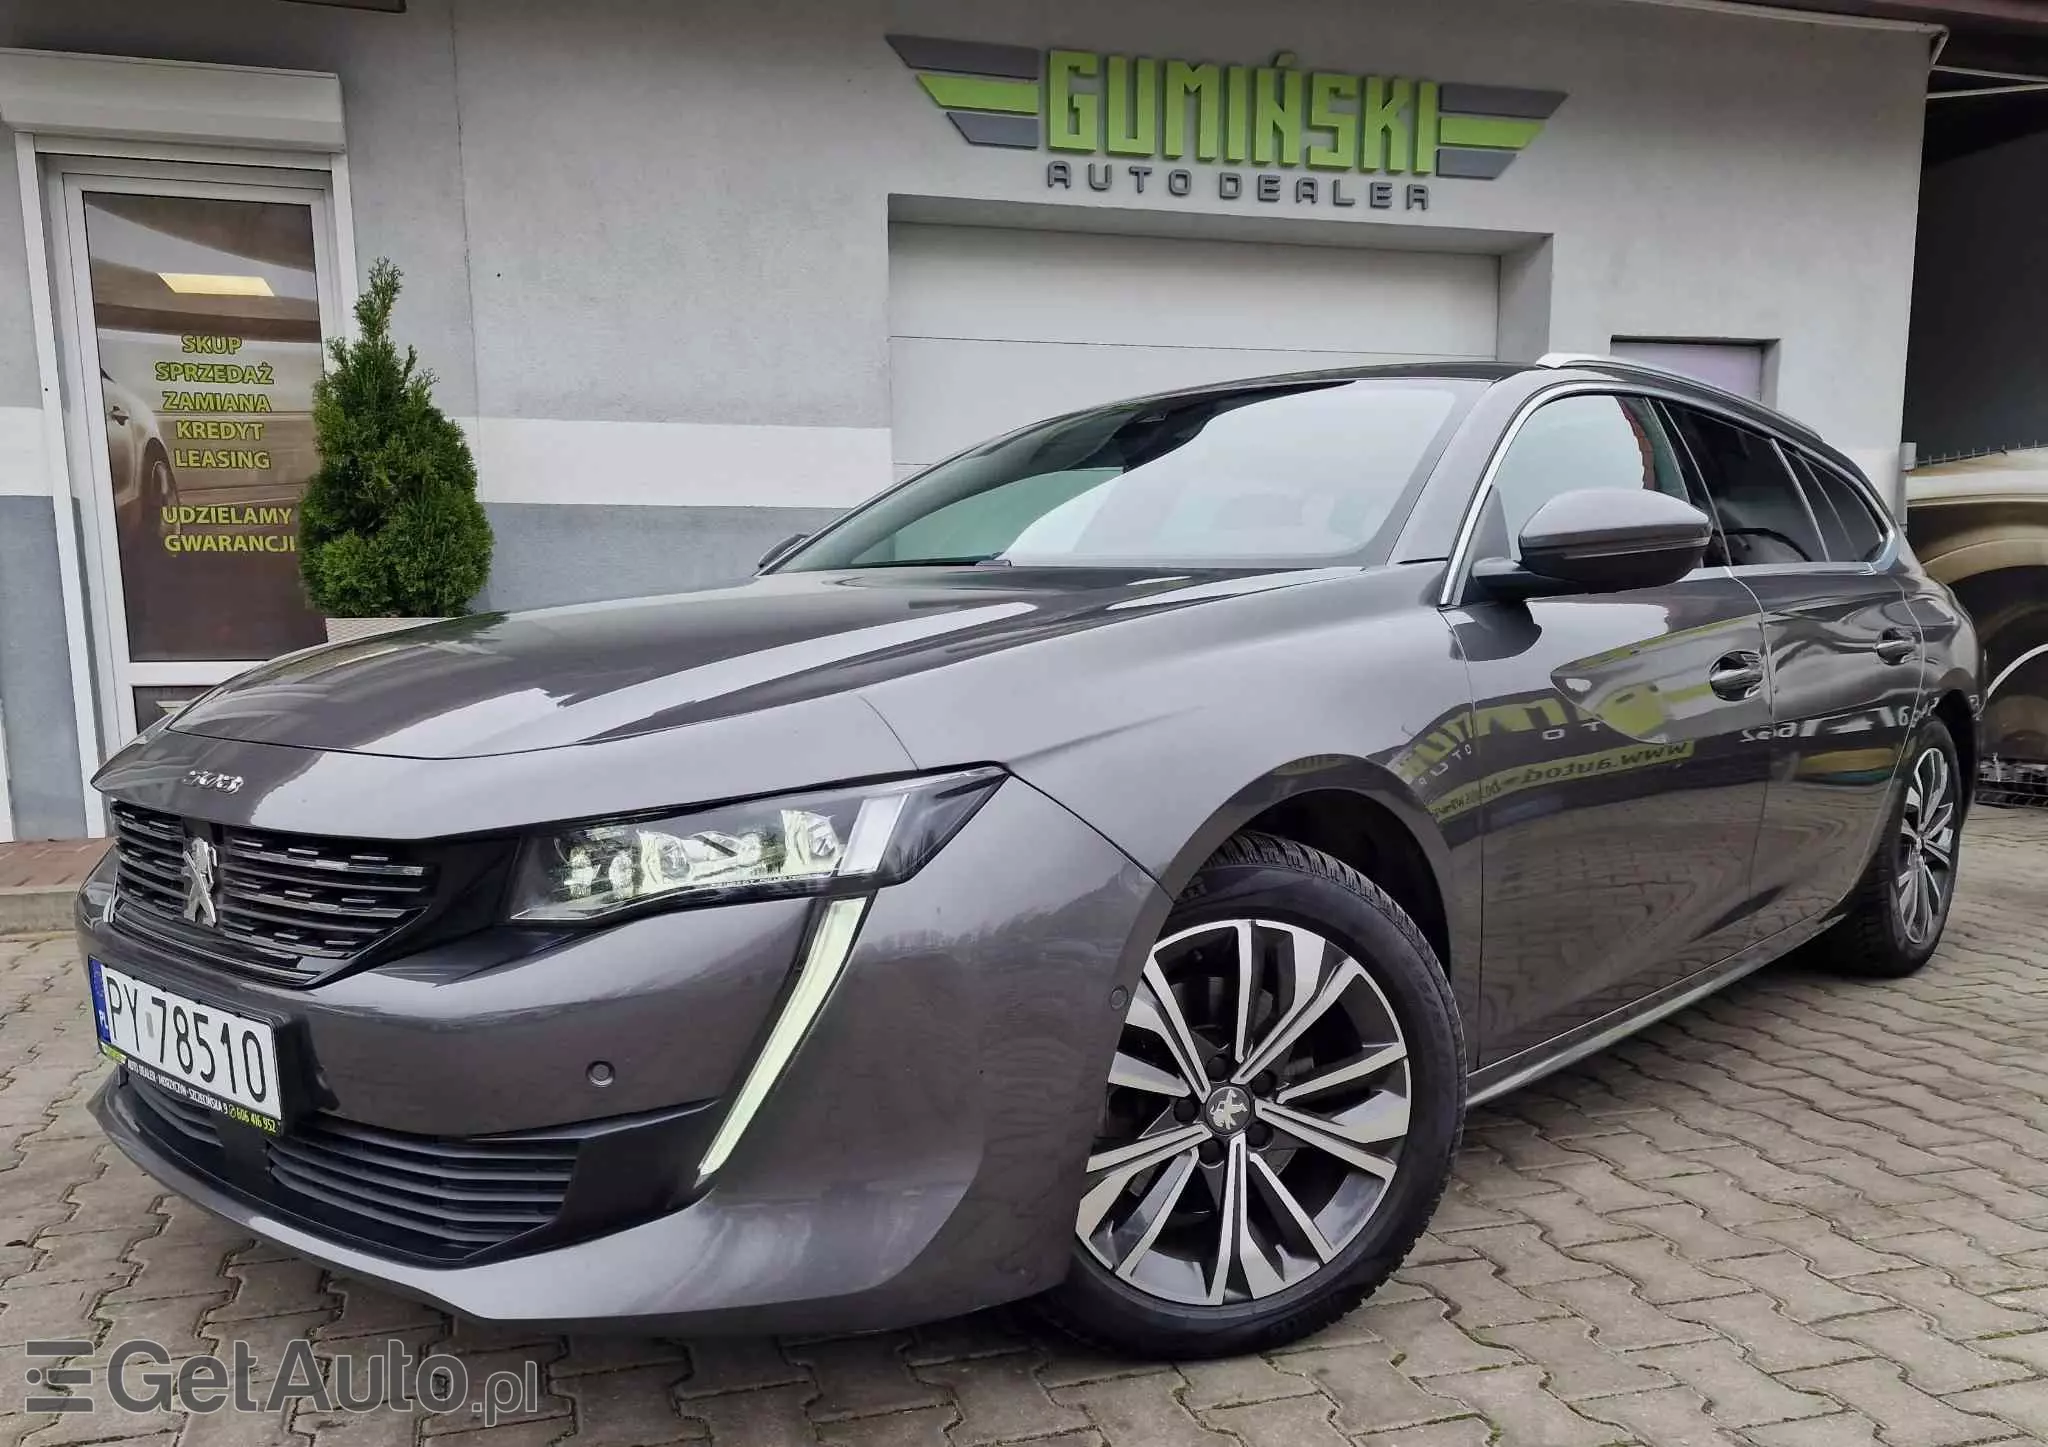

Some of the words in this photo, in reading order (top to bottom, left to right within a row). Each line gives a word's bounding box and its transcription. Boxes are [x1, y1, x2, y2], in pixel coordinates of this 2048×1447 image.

[1048, 49, 1439, 175] GUMIŃSKI
[1048, 160, 1193, 197] AUTO
[1219, 172, 1430, 211] DEALER
[181, 334, 243, 354] SKUP
[155, 362, 274, 385] SPRZEDAŻ
[162, 390, 272, 412] ZAMIANA
[176, 420, 264, 440] KREDYT
[174, 449, 271, 469] LEASING
[161, 505, 292, 525] UDZIELAMY
[164, 534, 295, 552] GWARANCJI
[106, 976, 140, 1052] PY
[152, 997, 267, 1103] 78510
